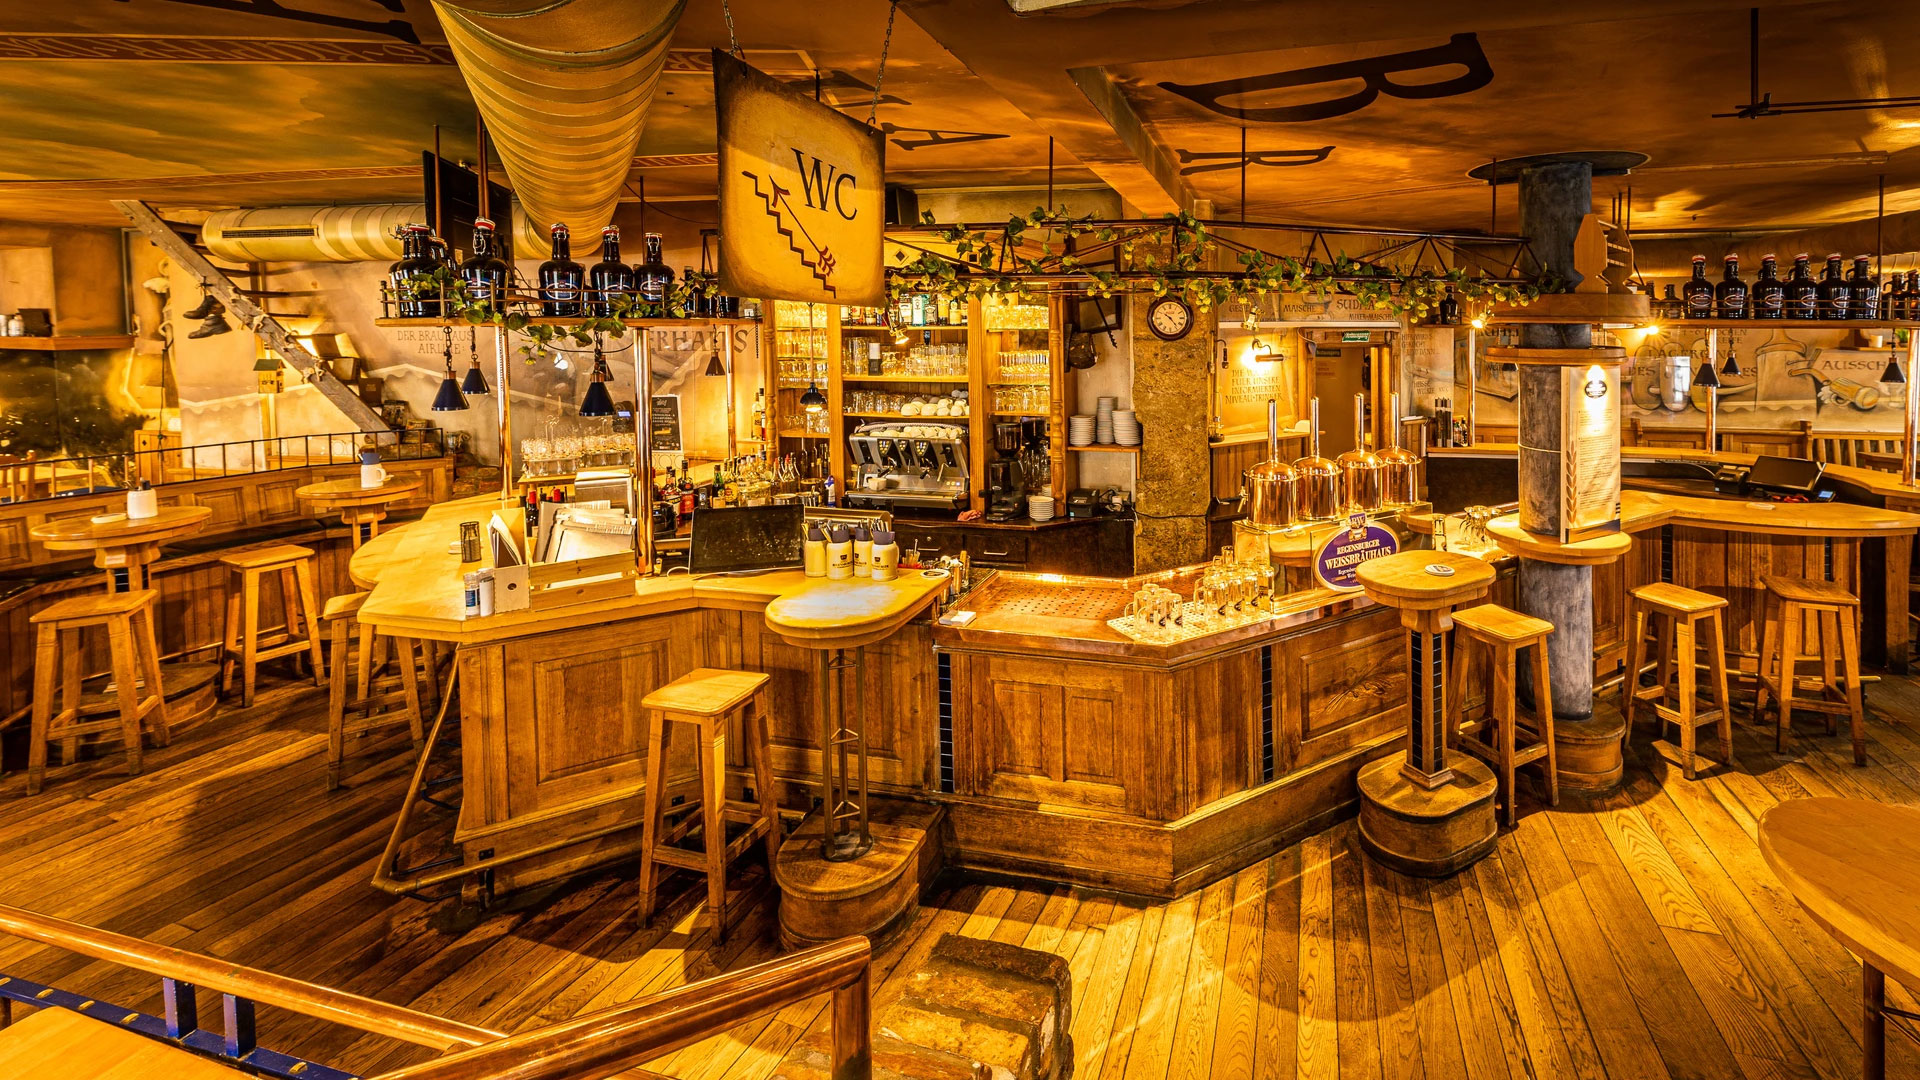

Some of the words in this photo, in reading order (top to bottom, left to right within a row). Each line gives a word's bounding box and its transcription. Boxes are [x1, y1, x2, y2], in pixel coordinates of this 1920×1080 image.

[790, 147, 858, 221] WC
[397, 330, 416, 341] DER
[418, 330, 473, 342] BRAUAUS
[1821, 360, 1907, 371] AUSSCH
[1336, 538, 1381, 556] REGENSBURGER
[1324, 545, 1392, 571] WEISSBRÄUHAUS
